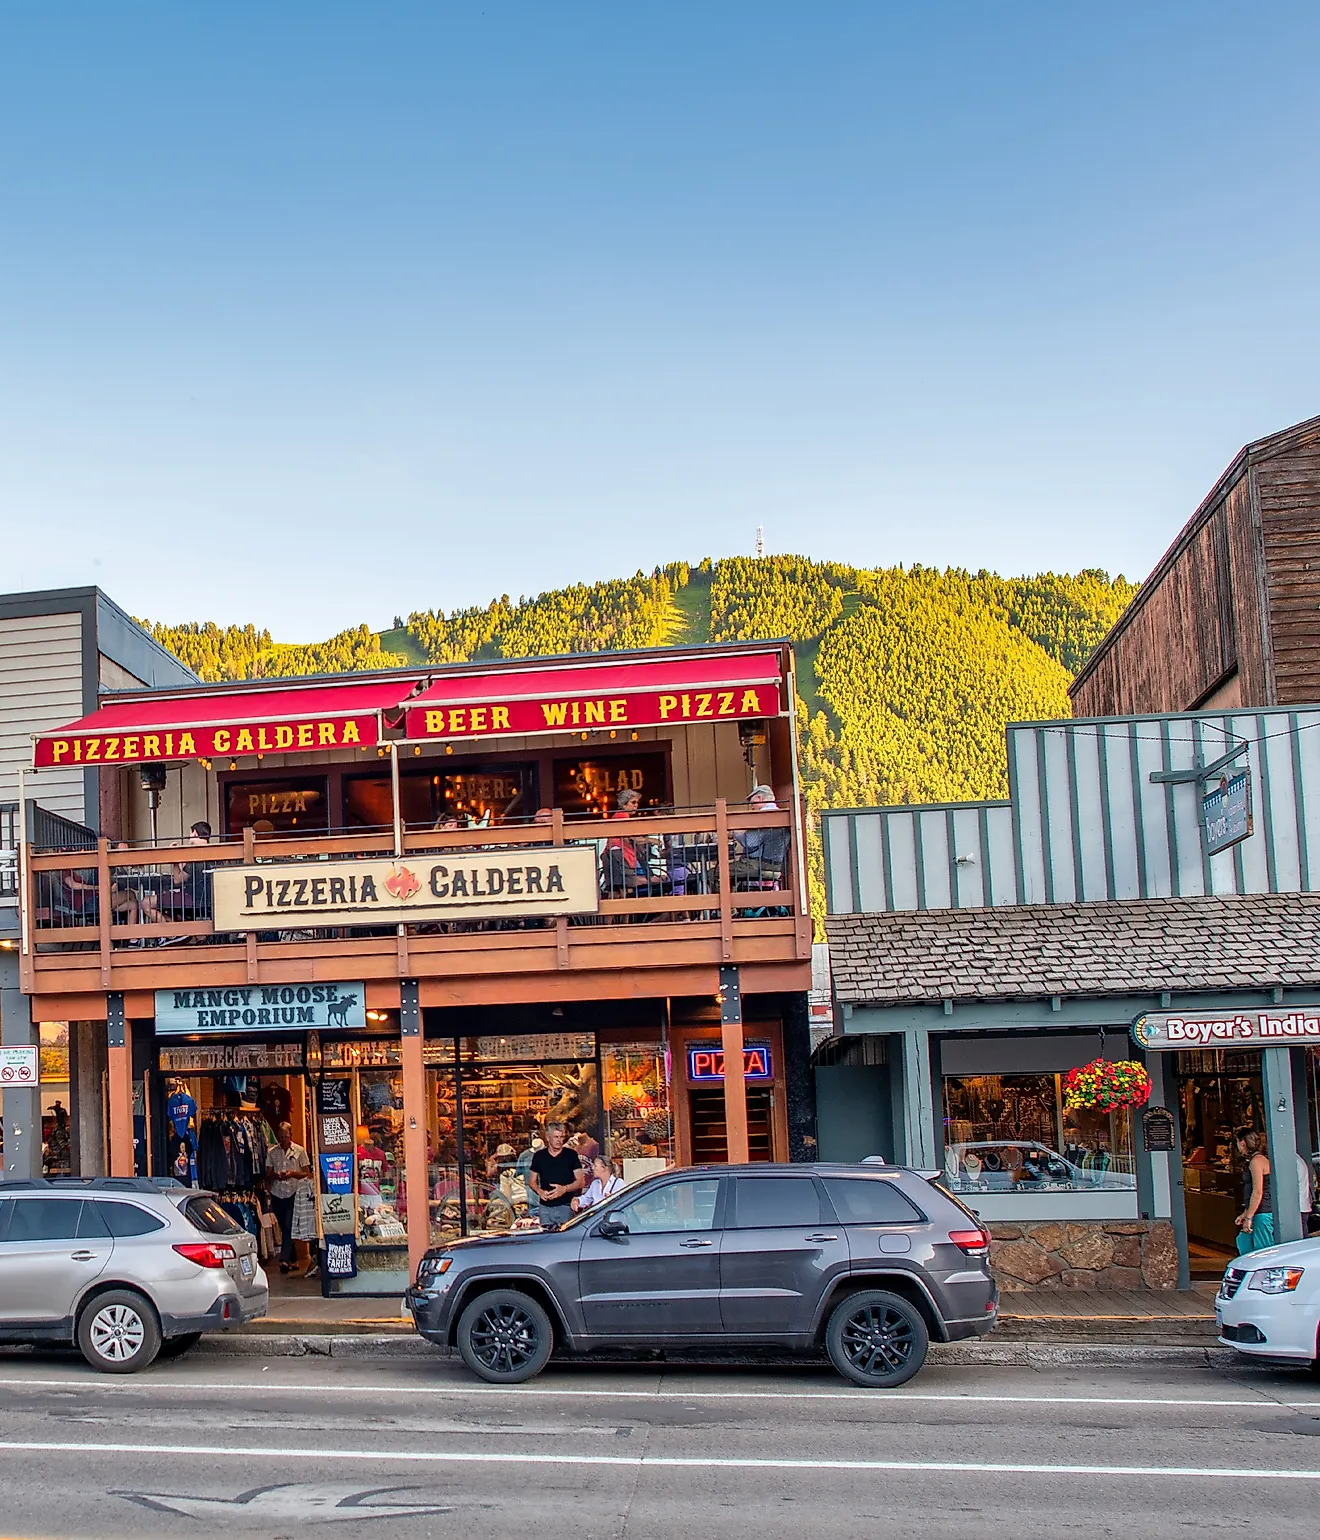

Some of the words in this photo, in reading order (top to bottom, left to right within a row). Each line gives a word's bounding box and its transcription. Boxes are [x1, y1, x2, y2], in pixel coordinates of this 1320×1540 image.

[425, 706, 511, 733] BEER
[541, 699, 628, 726] WINE
[658, 689, 762, 719] PIZZA
[52, 732, 197, 762] PIZZERIA
[212, 720, 361, 752] CALDERA
[249, 792, 307, 815] PIZZA
[243, 874, 379, 908] PIZZERIA
[428, 865, 566, 899] CALDERA
[173, 989, 252, 1008] MANGY
[261, 985, 338, 1005] MOOSE
[197, 1006, 315, 1027] EMPORIUM
[1167, 1016, 1253, 1044] Boyer's
[695, 1051, 765, 1076] PIZA
[327, 1177, 350, 1185] FRIES
